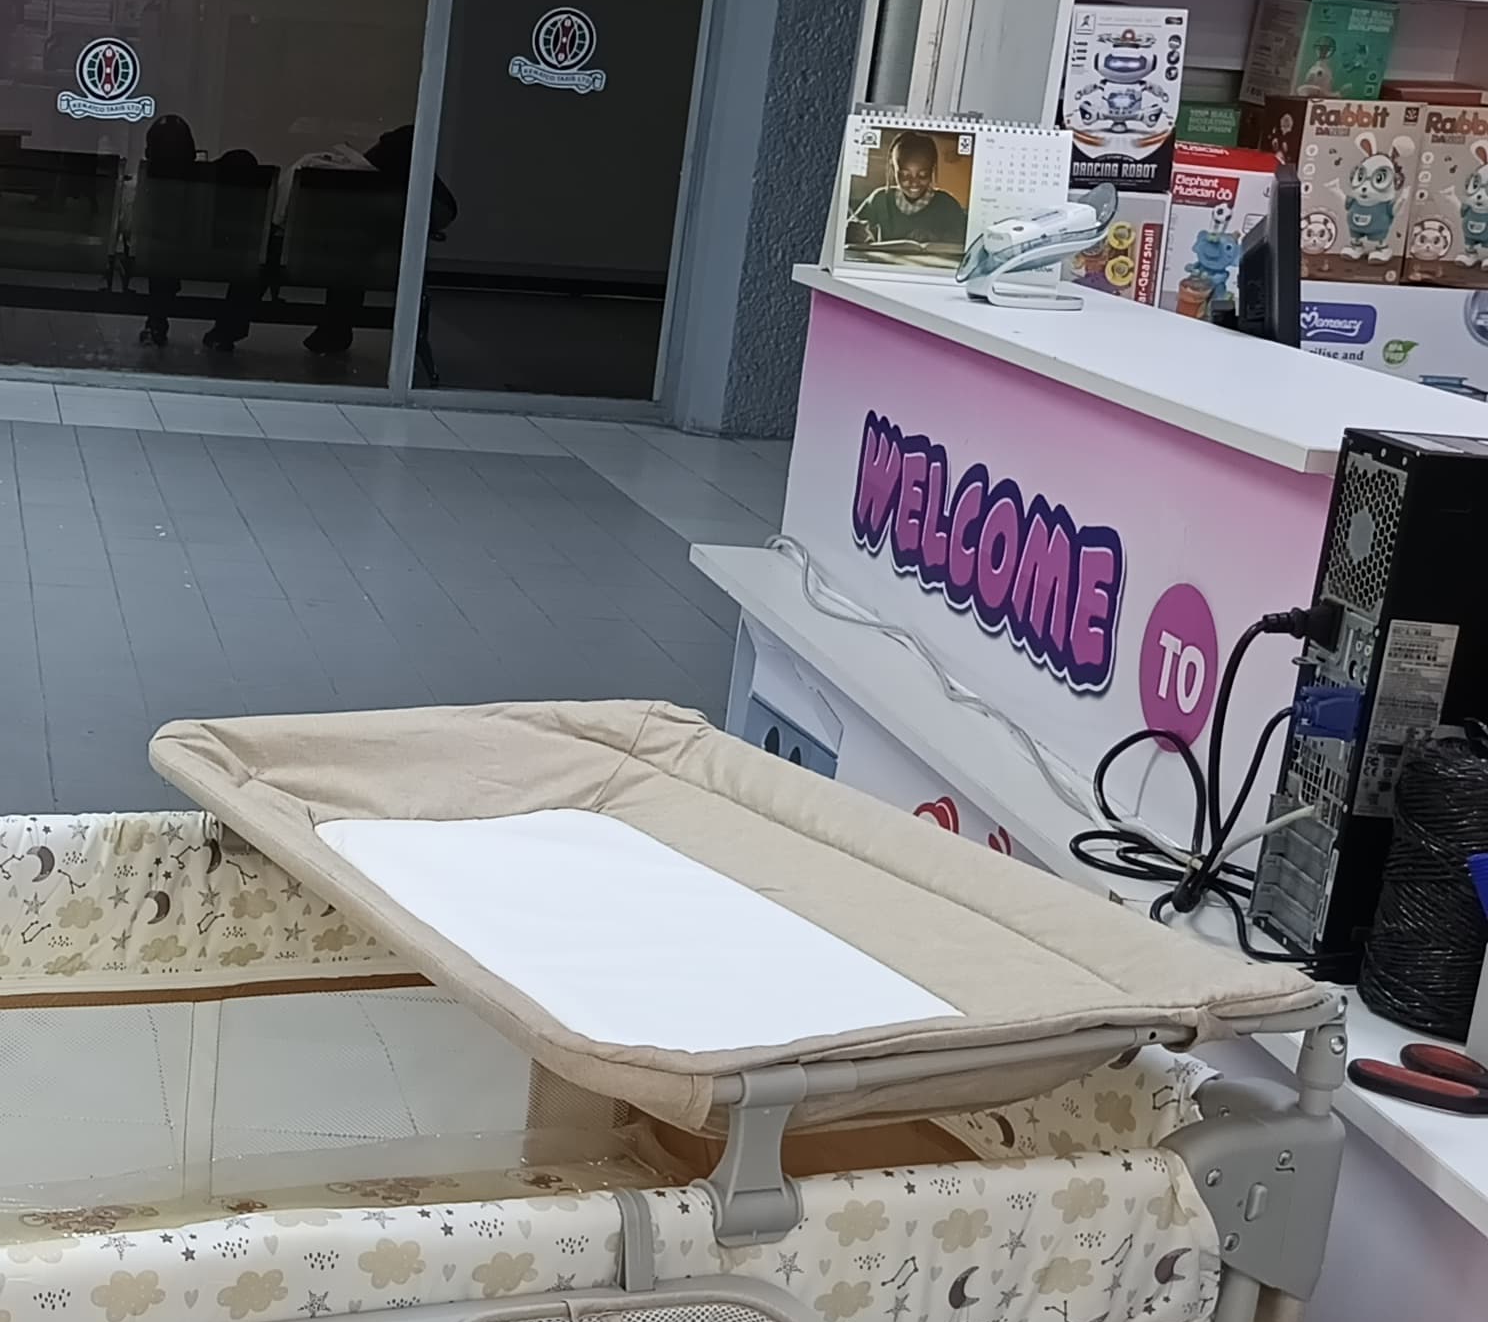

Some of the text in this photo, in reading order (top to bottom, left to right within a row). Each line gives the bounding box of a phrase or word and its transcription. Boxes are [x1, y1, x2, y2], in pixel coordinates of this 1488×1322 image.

[1310, 103, 1390, 128] Rabbit
[1425, 110, 1488, 135] Rabb
[1072, 161, 1158, 179] DANCING ROBOT
[1173, 185, 1216, 197] Musician
[1175, 174, 1219, 188] Elephant
[1342, 350, 1365, 361] and
[854, 413, 1122, 691] WELCOME
[1157, 631, 1205, 715] TO
